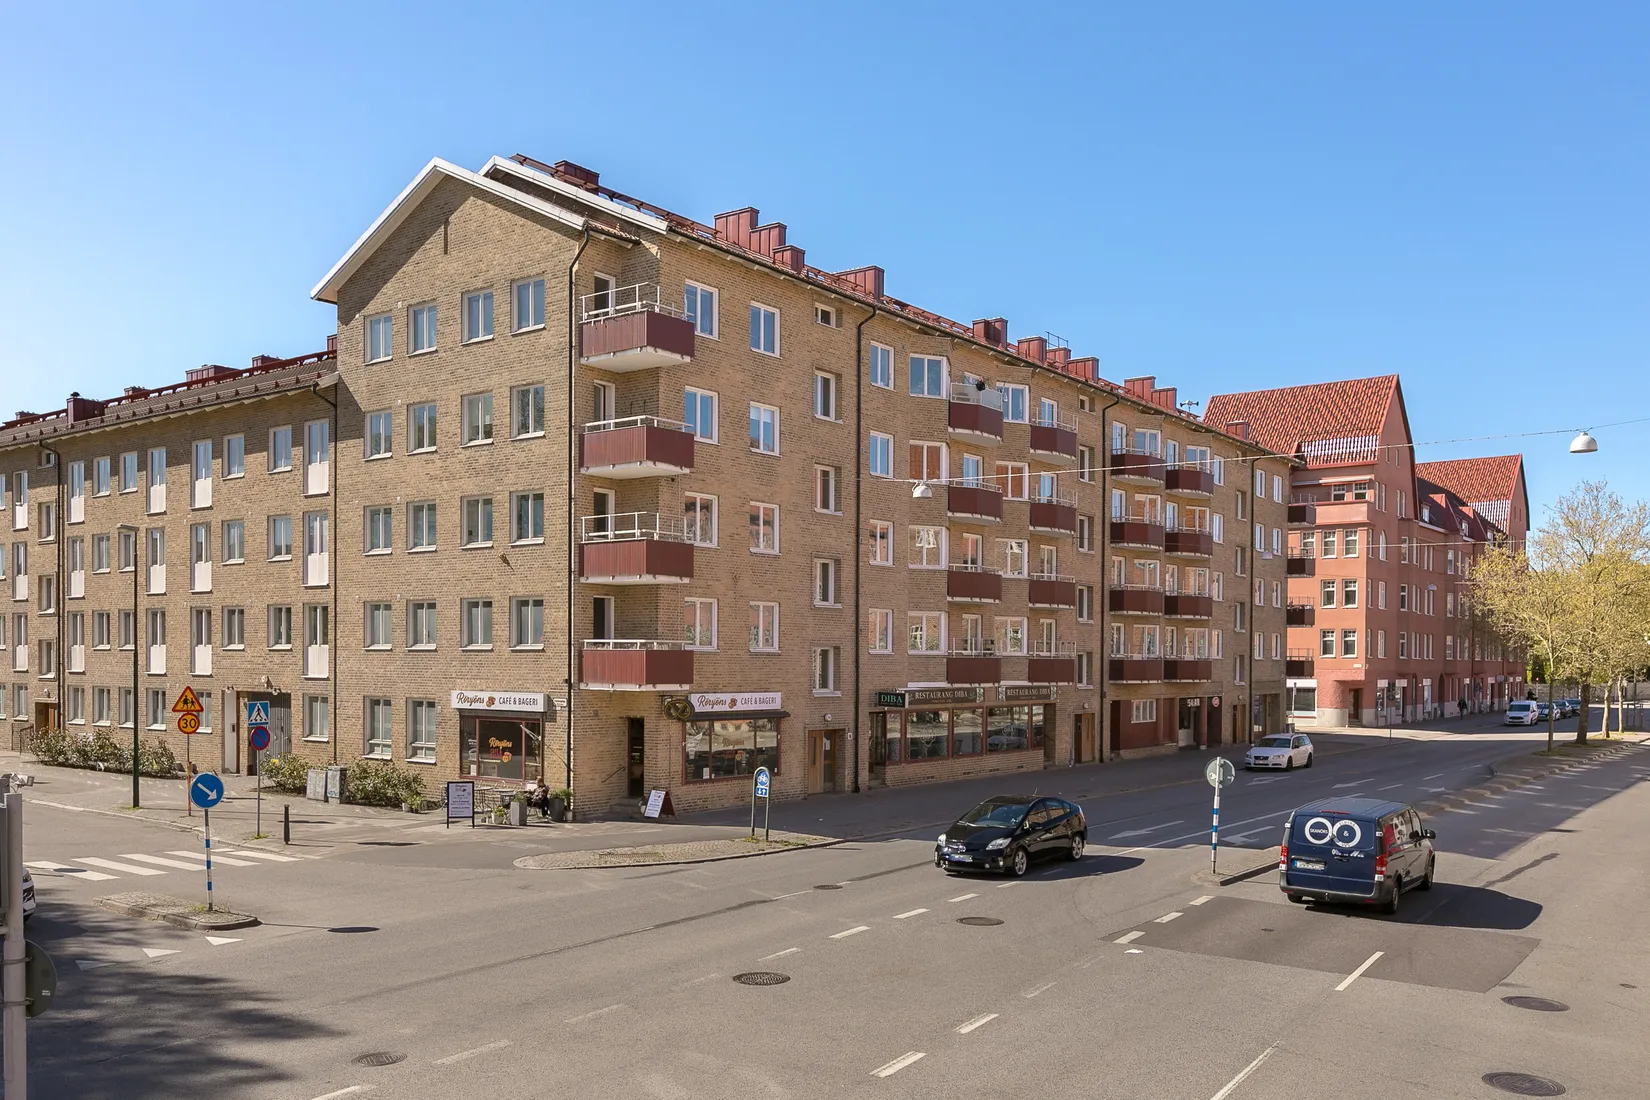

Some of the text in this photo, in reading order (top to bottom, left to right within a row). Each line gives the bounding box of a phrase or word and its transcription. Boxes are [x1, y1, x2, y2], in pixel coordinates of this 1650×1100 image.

[498, 695, 512, 705] CAFÉ
[513, 697, 517, 705] &
[518, 697, 538, 706] BAGERI
[740, 695, 753, 706] CAFÉ
[754, 697, 758, 705] &
[759, 696, 777, 705] BAGERI
[881, 694, 903, 703] DIBA
[915, 690, 968, 700] RESTAURANG DIBA
[181, 718, 197, 729] 30
